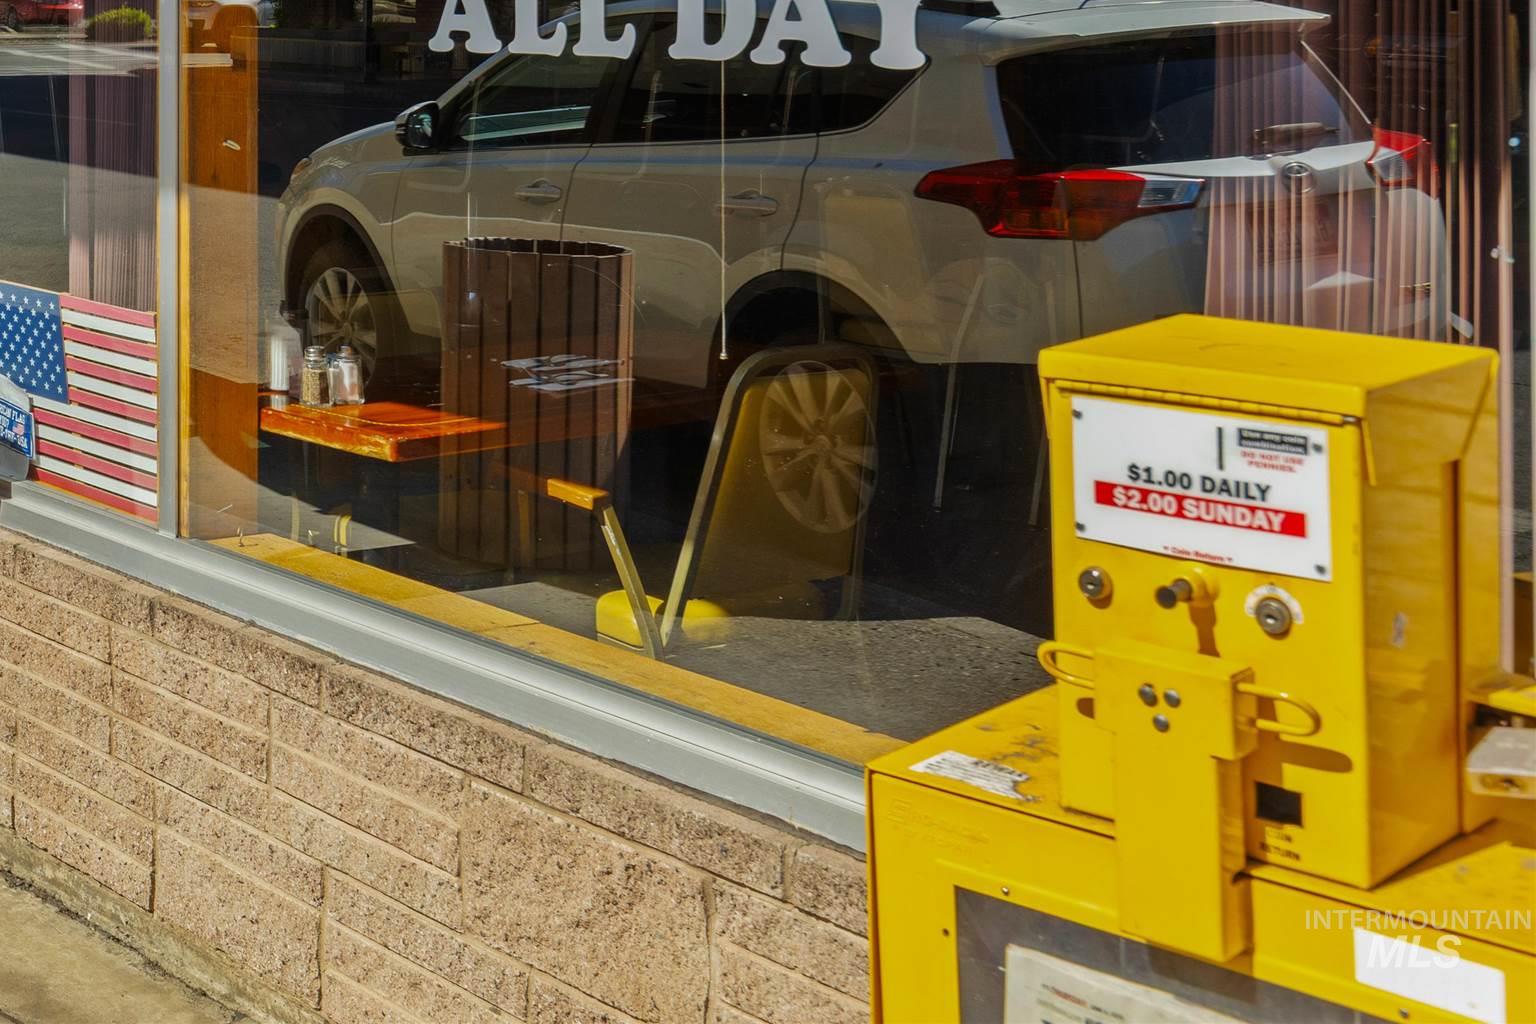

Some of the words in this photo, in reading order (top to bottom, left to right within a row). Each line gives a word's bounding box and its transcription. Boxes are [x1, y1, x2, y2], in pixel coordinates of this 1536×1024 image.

[1127, 462, 1193, 491] $1.00
[1200, 475, 1272, 502] DAILY
[1111, 486, 1178, 515] $2.00
[1181, 497, 1287, 532] SUNDAY
